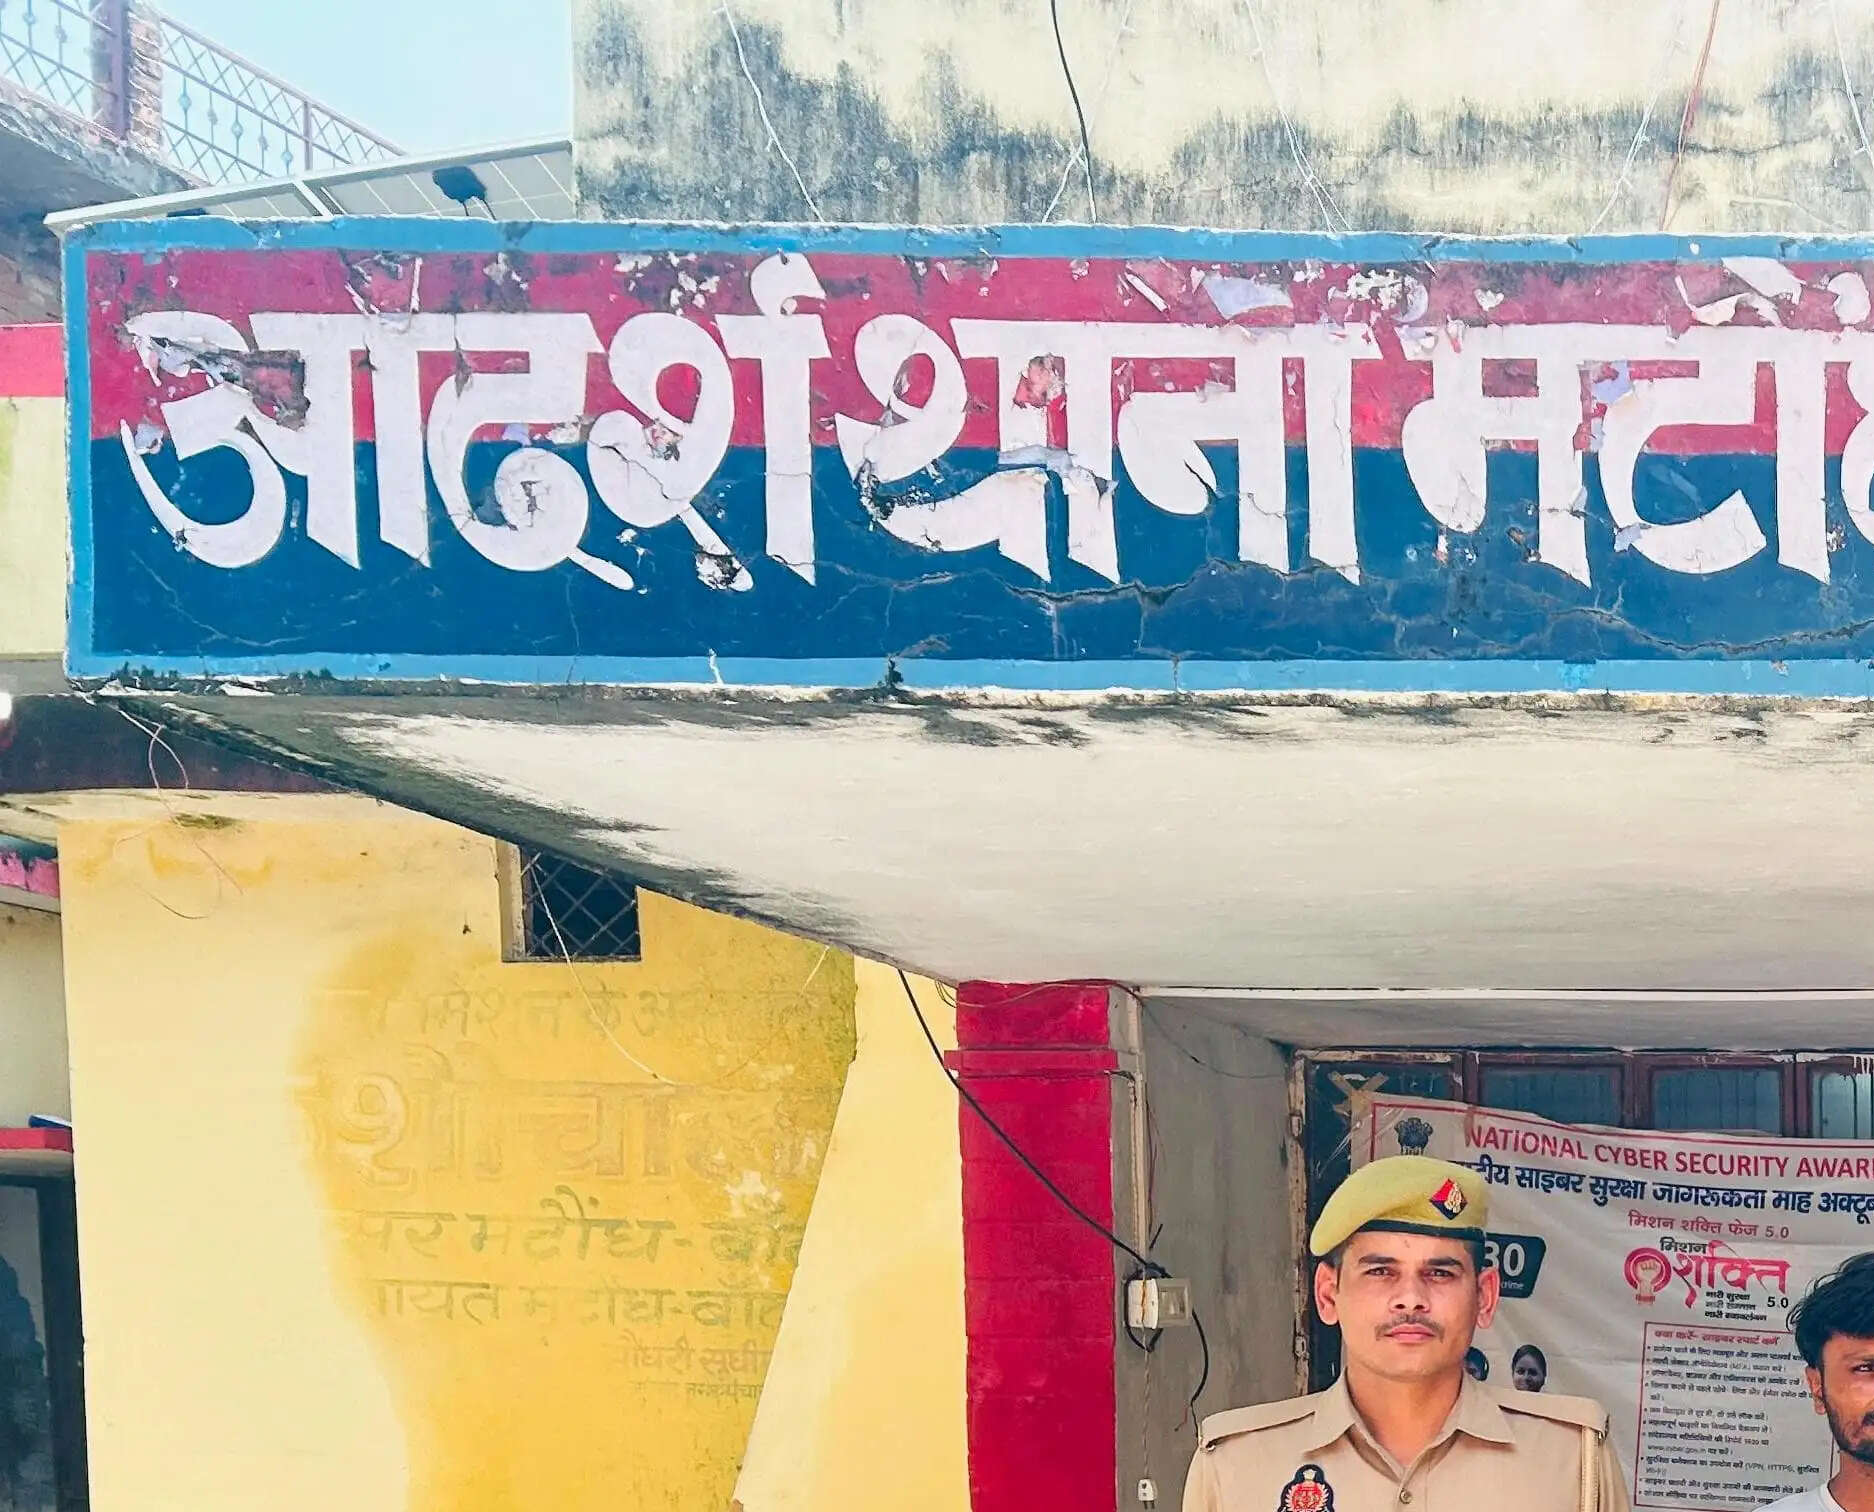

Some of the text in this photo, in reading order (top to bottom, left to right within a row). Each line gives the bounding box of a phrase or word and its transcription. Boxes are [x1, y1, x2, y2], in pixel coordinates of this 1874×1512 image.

[836, 312, 1384, 586] थाना
[1465, 1124, 1588, 1161] NATIONAL
[1594, 1144, 1668, 1171] CYBER
[1675, 1149, 1789, 1178] SECURITY
[1515, 1166, 1586, 1195] साइबर
[1589, 1175, 1647, 1207] सुरक्षा
[1652, 1181, 1767, 1210] जागरूकता
[1772, 1190, 1812, 1213] माह
[1627, 1209, 1789, 1239] मिशन शक्ति फेज 5.0
[1660, 1236, 1708, 1254] मिशन
[1673, 1240, 1791, 1309] शक्ति
[1767, 1296, 1789, 1309] 5.0
